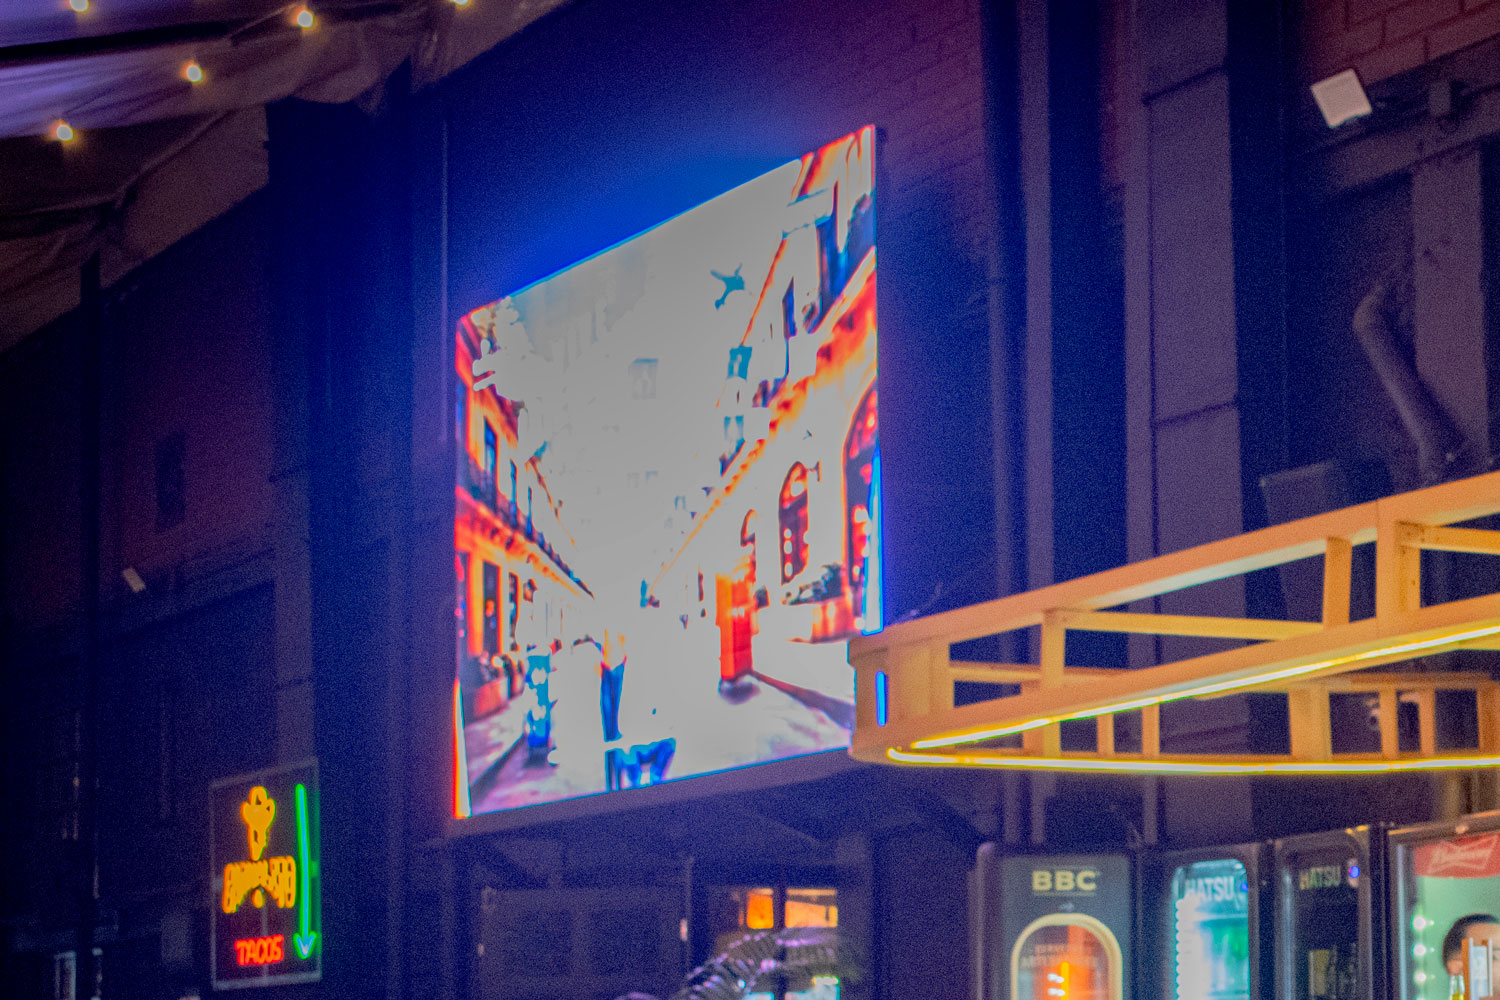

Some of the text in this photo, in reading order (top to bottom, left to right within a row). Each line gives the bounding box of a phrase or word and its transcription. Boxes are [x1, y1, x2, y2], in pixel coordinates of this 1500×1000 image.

[1032, 870, 1097, 891] BBC
[1300, 866, 1341, 890] HATSU
[235, 934, 284, 966] TACOS
